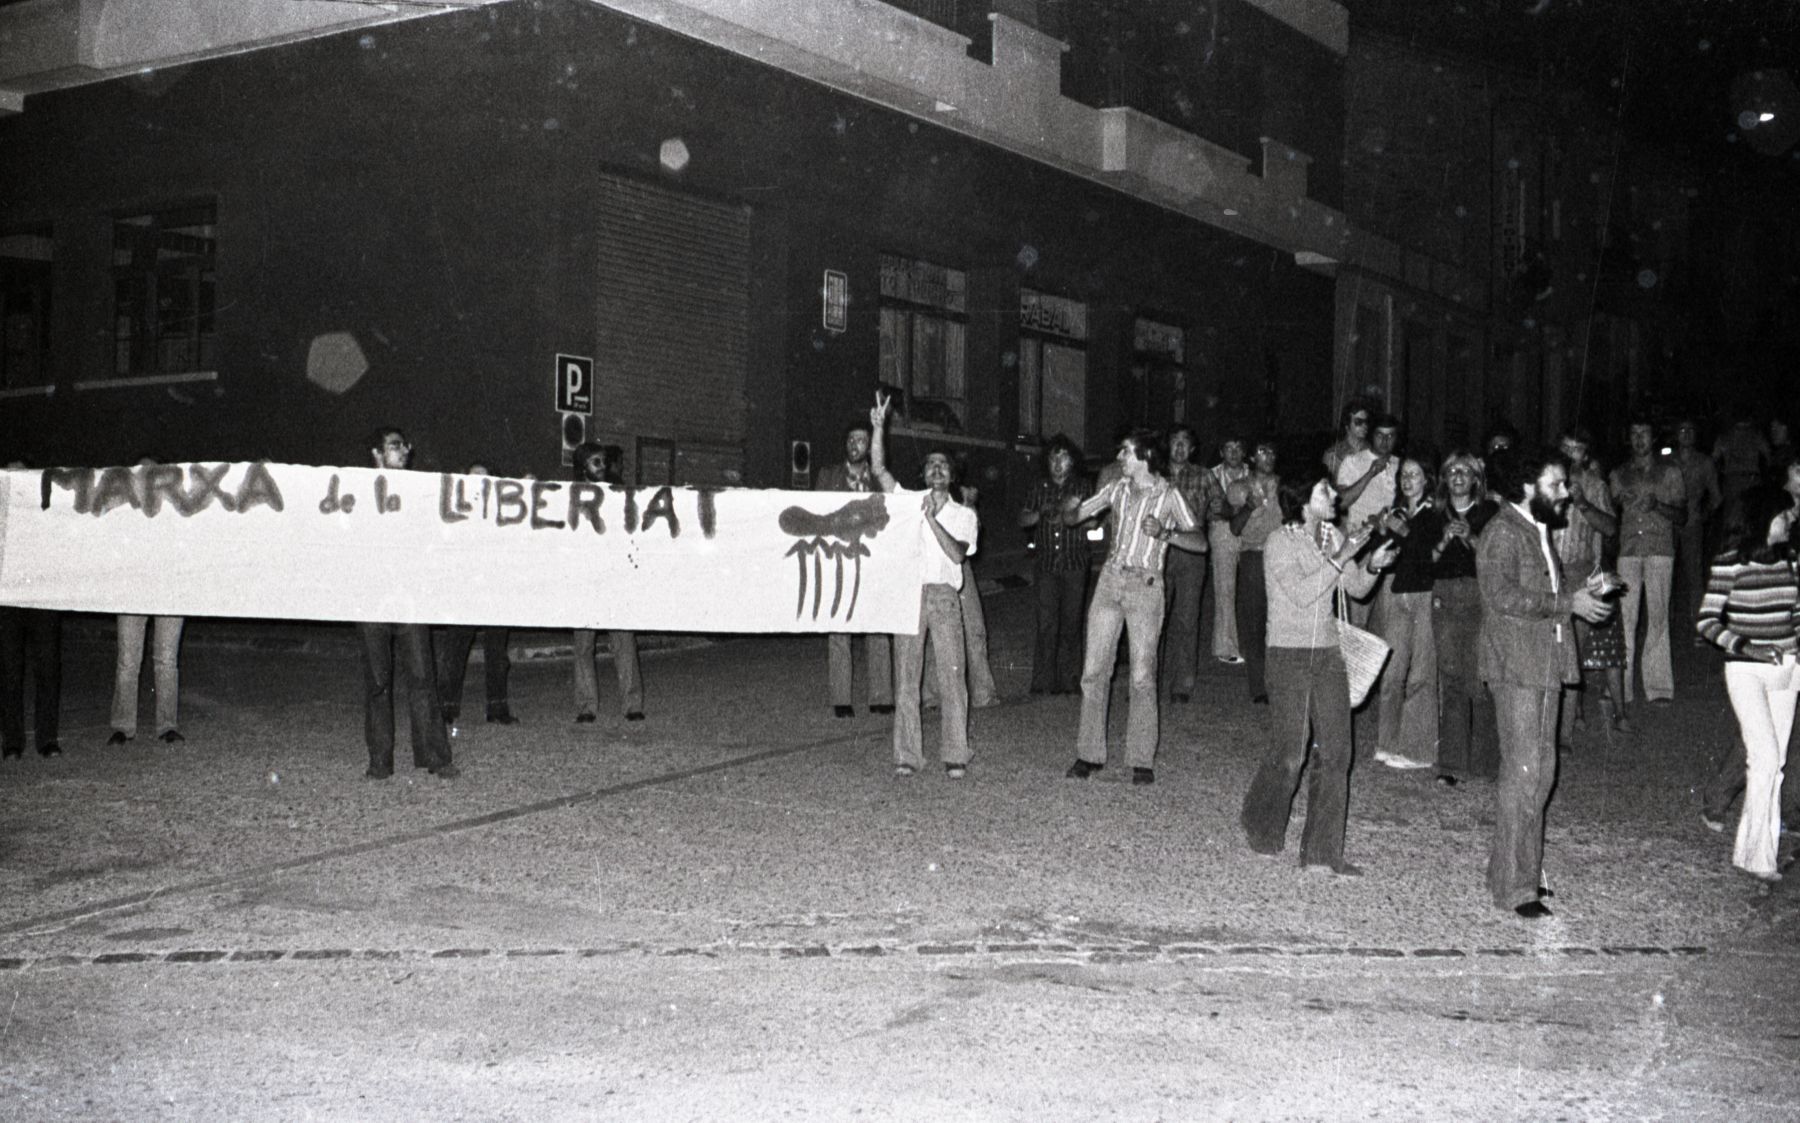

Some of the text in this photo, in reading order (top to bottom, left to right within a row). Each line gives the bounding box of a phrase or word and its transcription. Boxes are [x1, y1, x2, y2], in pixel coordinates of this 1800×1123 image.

[566, 363, 582, 406] P
[41, 463, 284, 518] MARXA
[319, 474, 356, 514] de
[439, 474, 726, 539] LLIBERTAT
